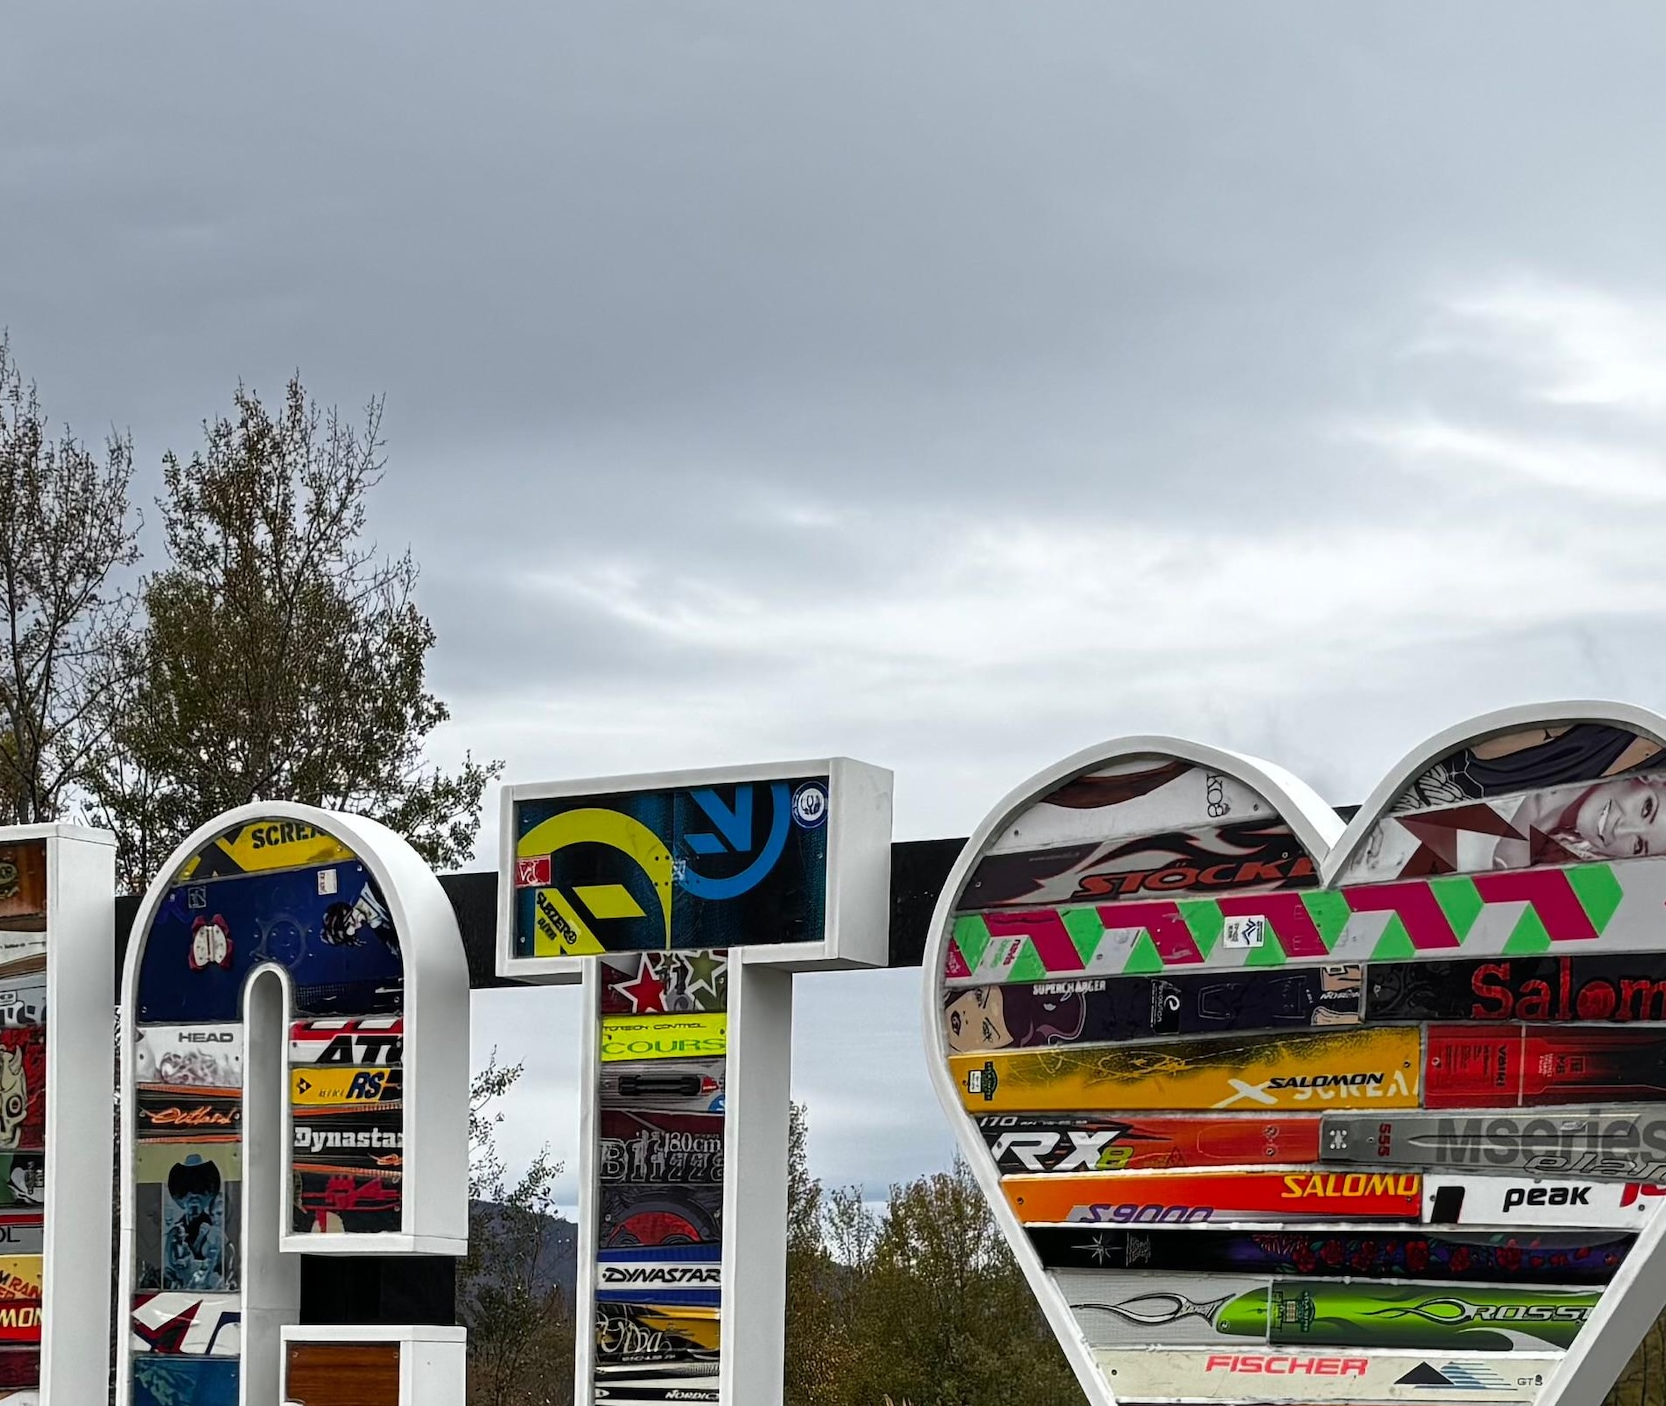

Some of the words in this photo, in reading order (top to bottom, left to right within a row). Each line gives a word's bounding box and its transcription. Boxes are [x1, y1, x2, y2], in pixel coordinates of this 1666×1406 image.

[178, 1031, 234, 1043] HEAD
[1268, 1072, 1385, 1090] SALOMON
[980, 1115, 1018, 1128] 170
[1501, 1185, 1592, 1213] peak
[1205, 1354, 1369, 1377] FISCHER
